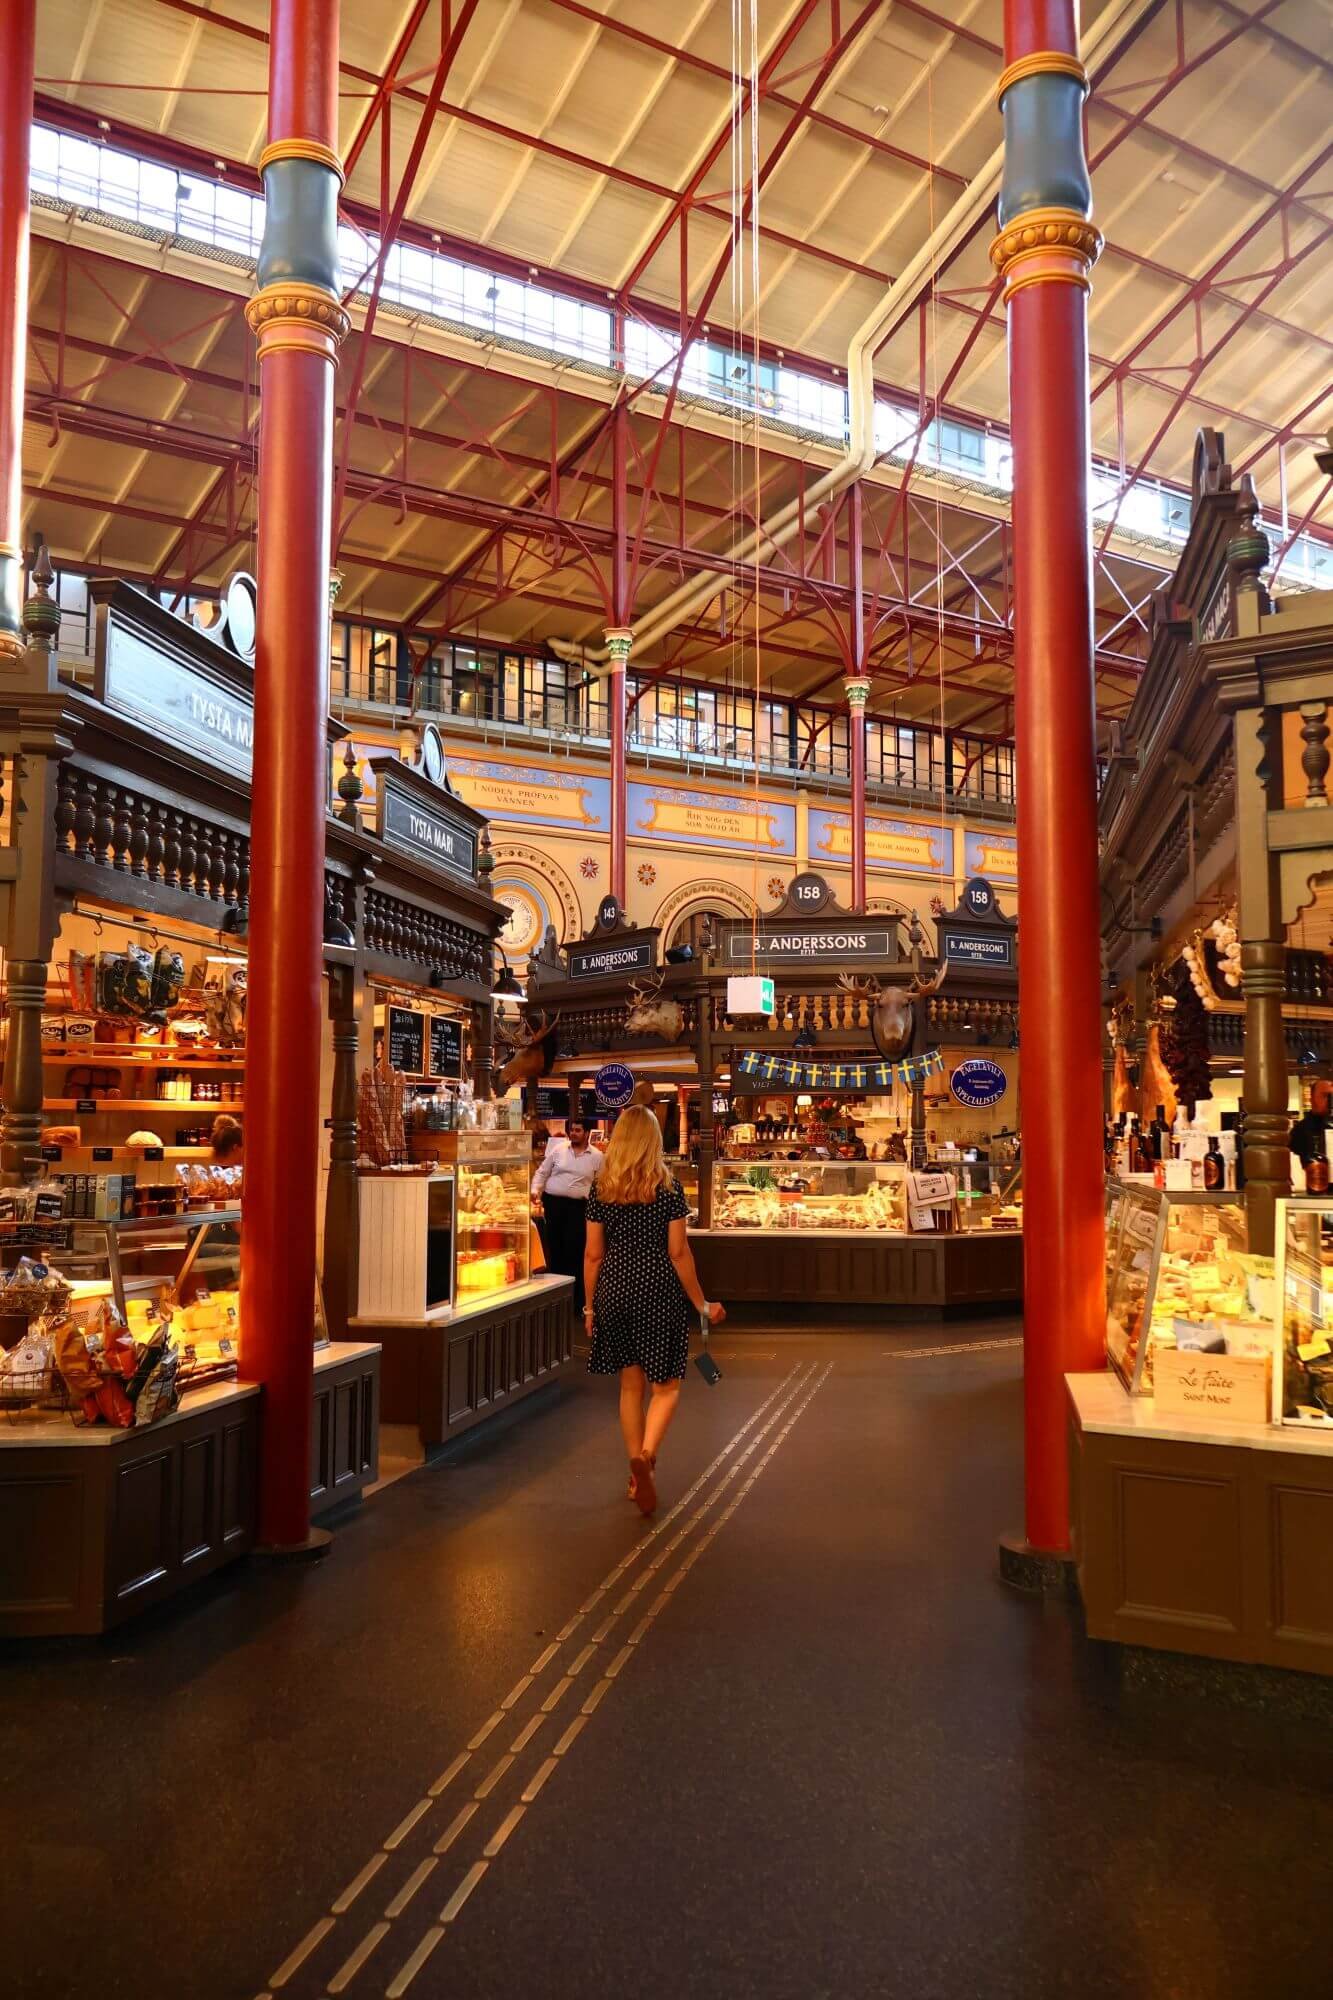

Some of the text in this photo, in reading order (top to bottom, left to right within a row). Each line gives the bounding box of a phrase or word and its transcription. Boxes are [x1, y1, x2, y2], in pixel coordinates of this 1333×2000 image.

[191, 692, 233, 740] TYSTA
[409, 814, 454, 855] TYSTA MARI
[797, 886, 821, 900] 158
[971, 890, 988, 905] 158
[603, 906, 616, 920] 143
[753, 935, 867, 951] B. ANDERSSONS
[950, 940, 1004, 954] B. ANDERSSONS
[581, 950, 639, 970] B. ANDERSSONS
